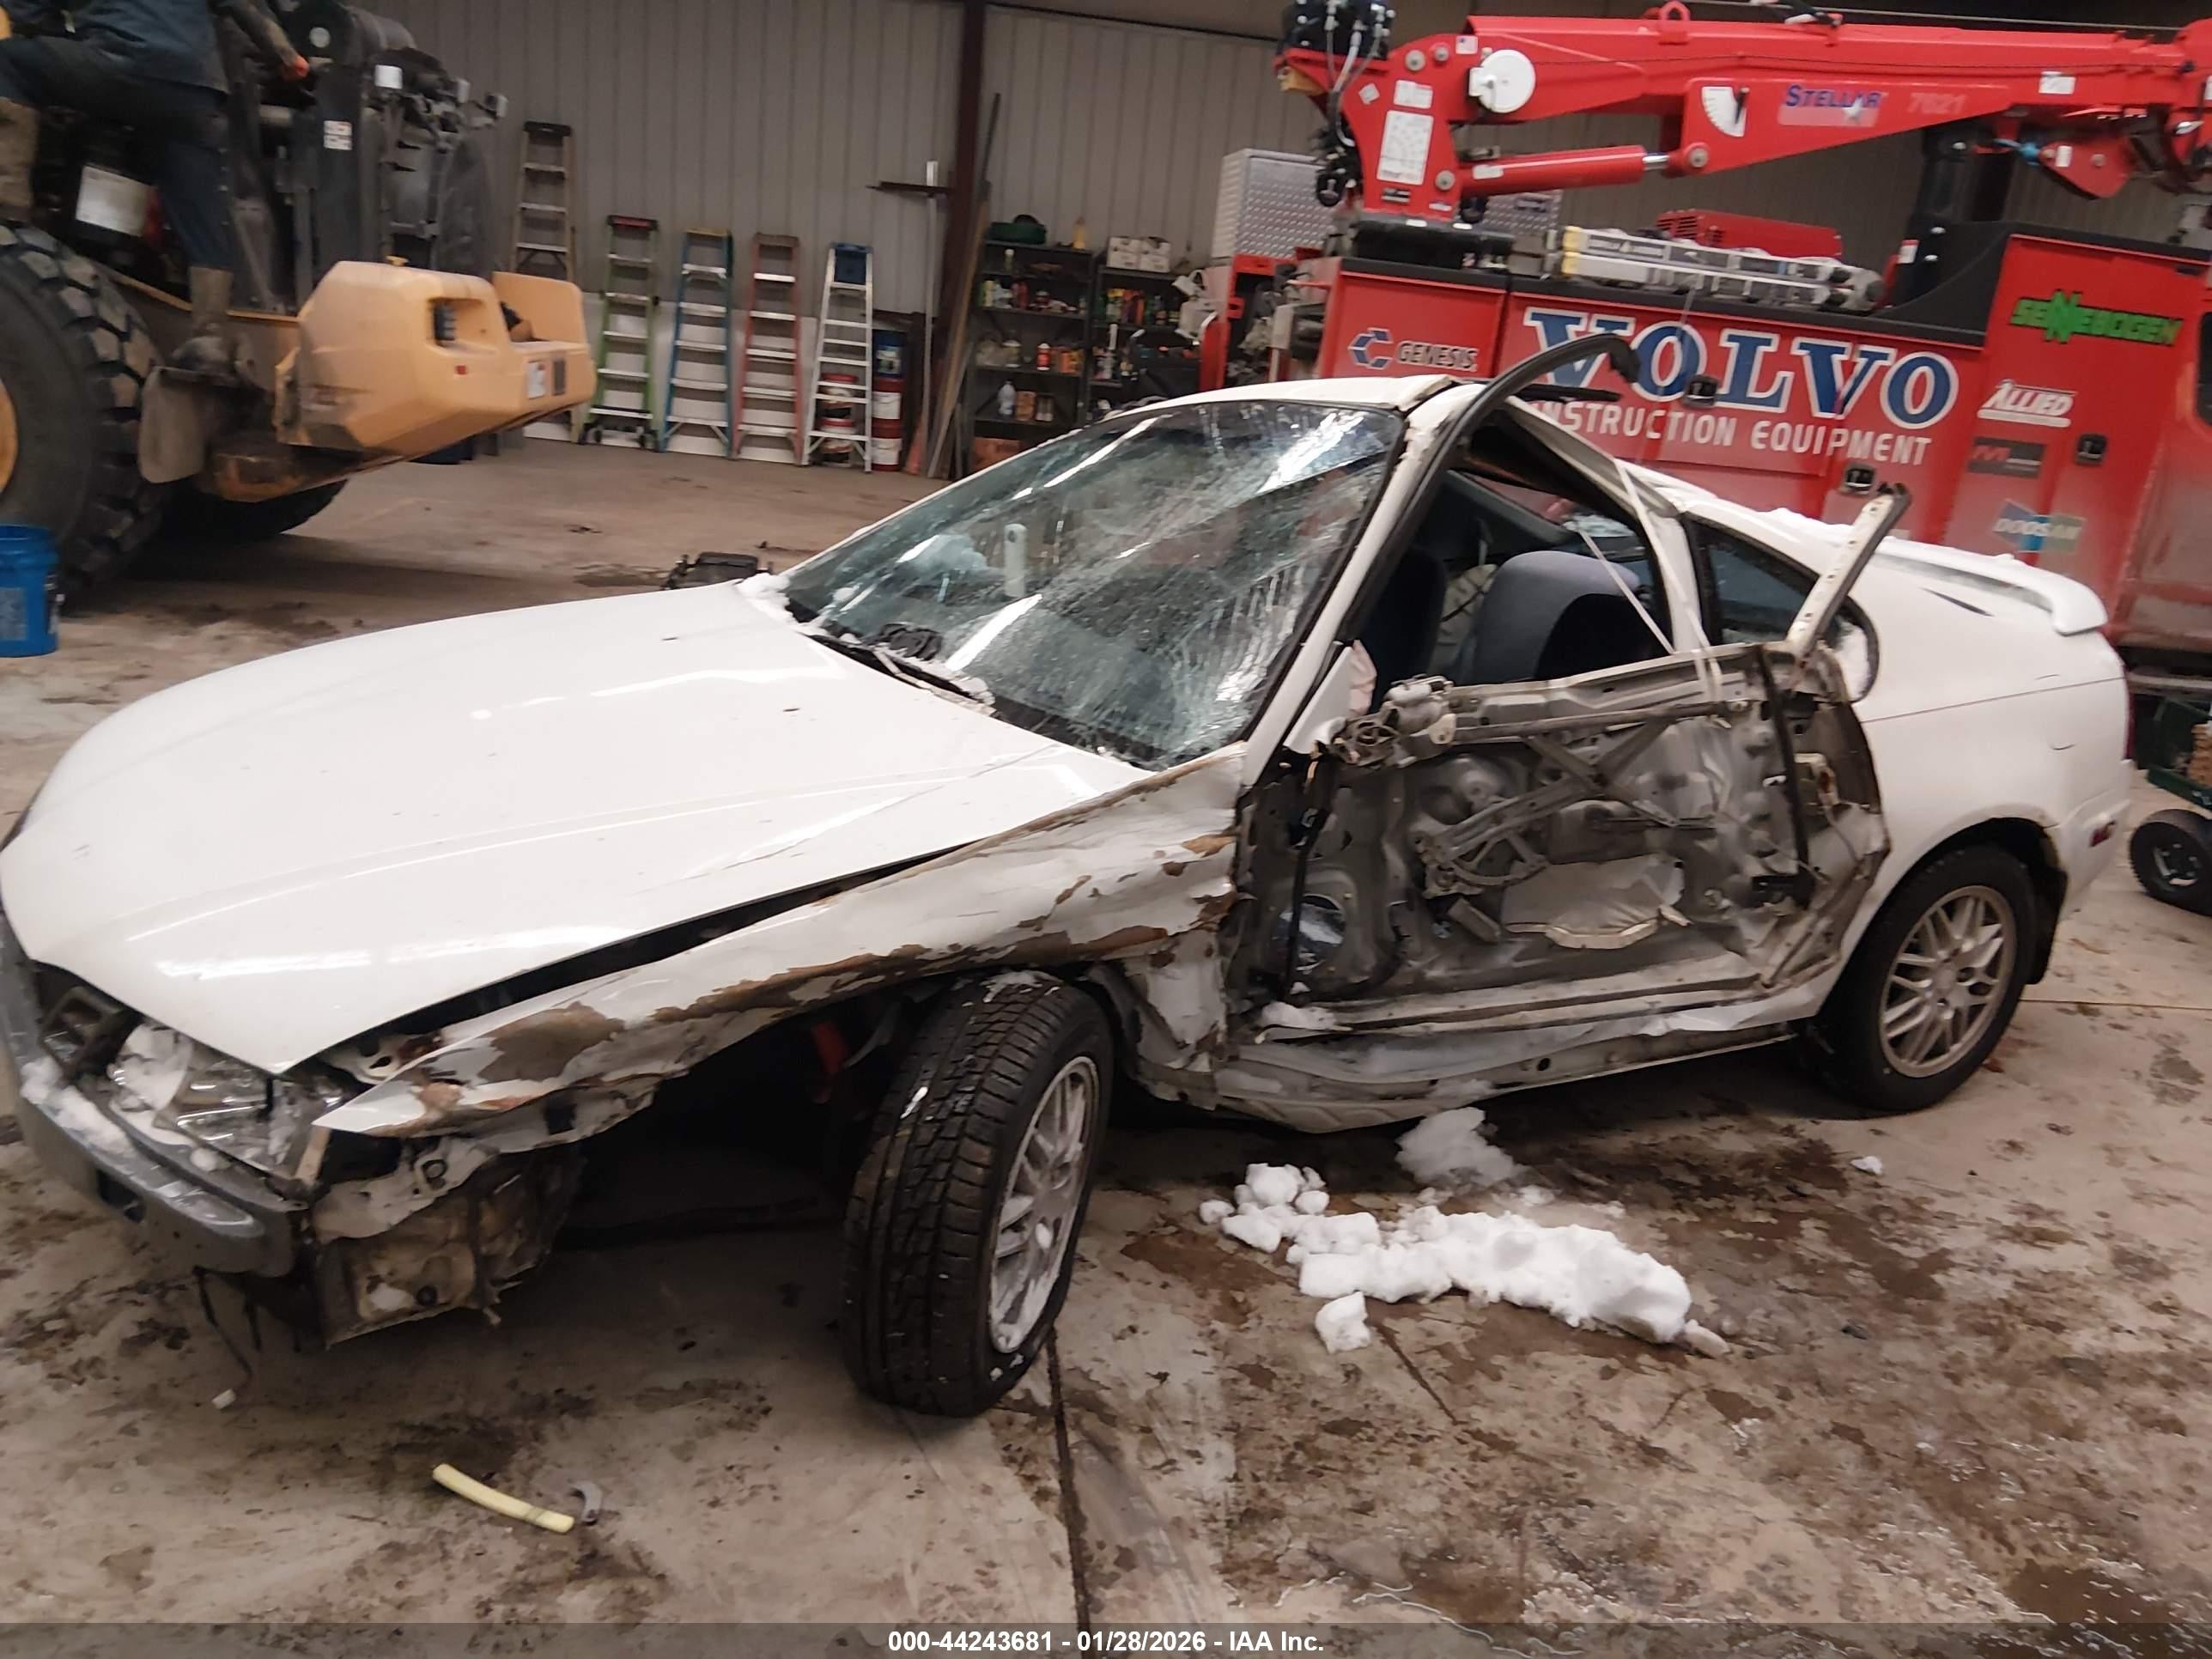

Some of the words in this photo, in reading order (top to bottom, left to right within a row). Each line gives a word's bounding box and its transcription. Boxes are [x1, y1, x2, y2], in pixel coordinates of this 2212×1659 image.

[1395, 340, 1478, 372] GENESIS
[1523, 306, 1959, 429] VOLVO
[1981, 378, 2074, 416] ALLIED
[1750, 419, 1932, 465] EQUIPMENT
